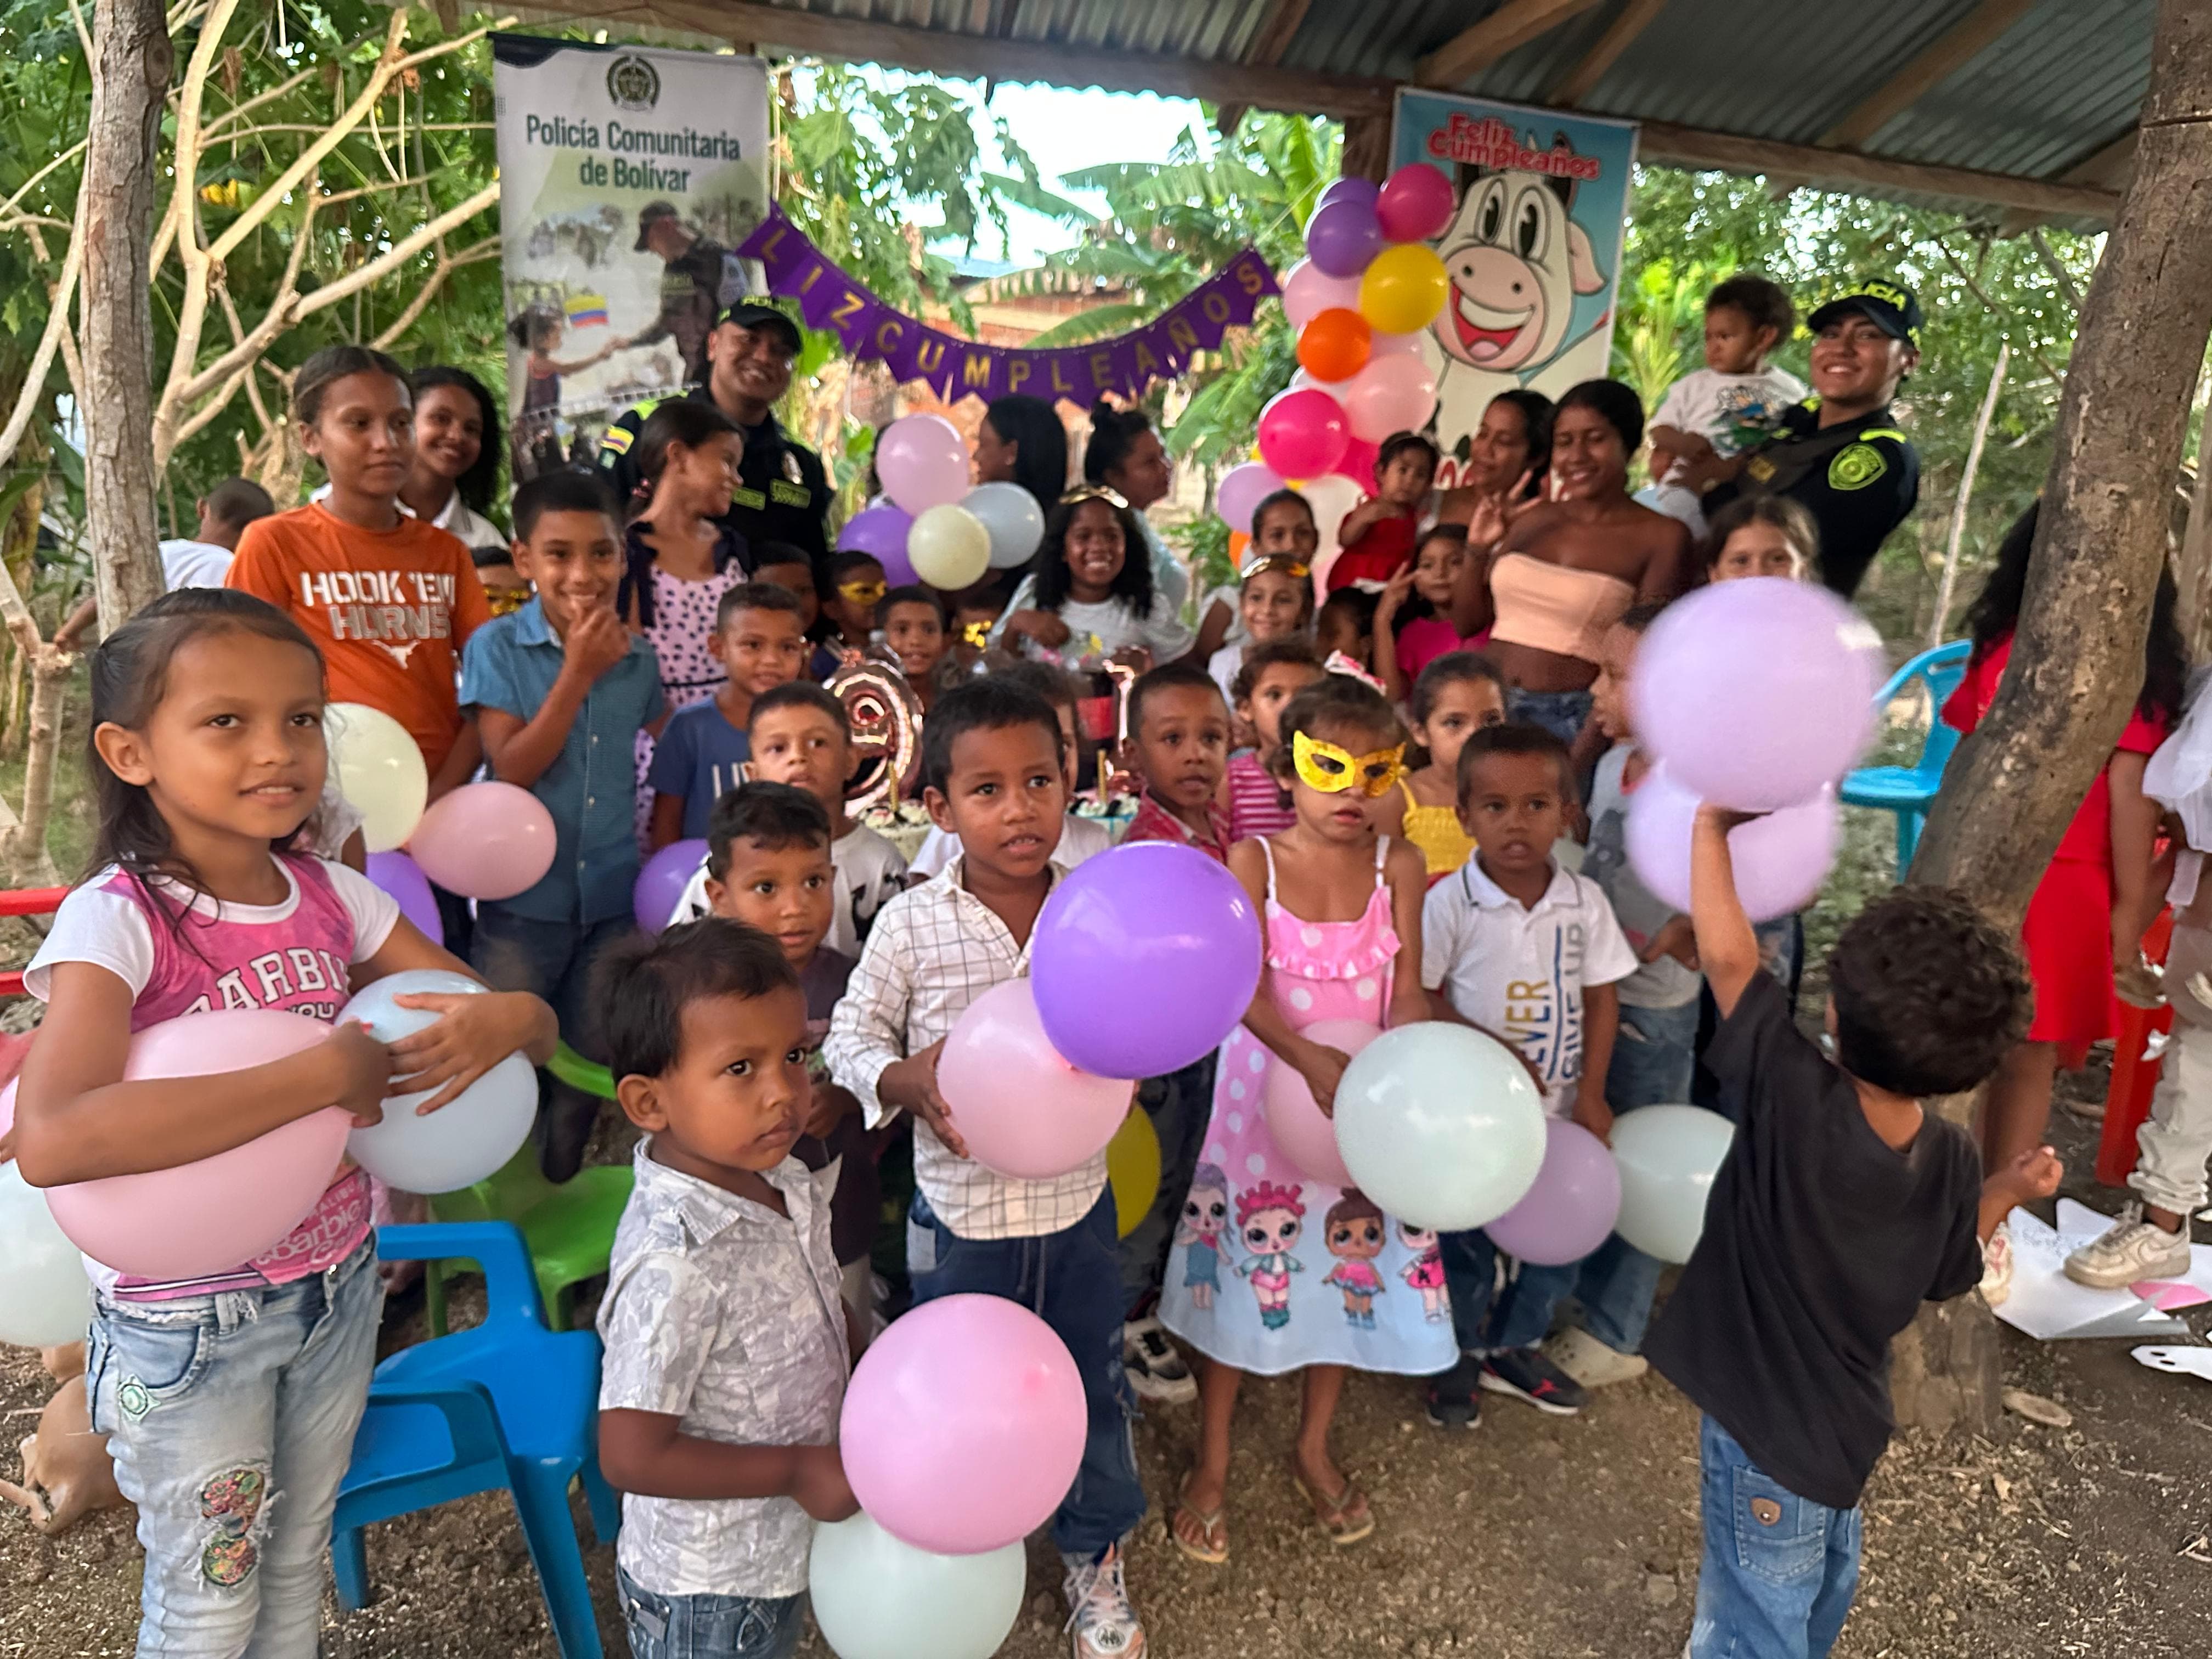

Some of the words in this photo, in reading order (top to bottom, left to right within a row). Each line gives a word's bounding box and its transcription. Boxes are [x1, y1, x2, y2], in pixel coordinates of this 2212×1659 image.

[527, 114, 600, 149] Policía
[607, 121, 742, 161] Comunitaria
[1449, 113, 1515, 145] Feliz
[1428, 129, 1600, 179] Cumpleaños
[580, 155, 608, 187] de
[613, 157, 691, 193] Bolívar
[300, 570, 407, 607] HOOK
